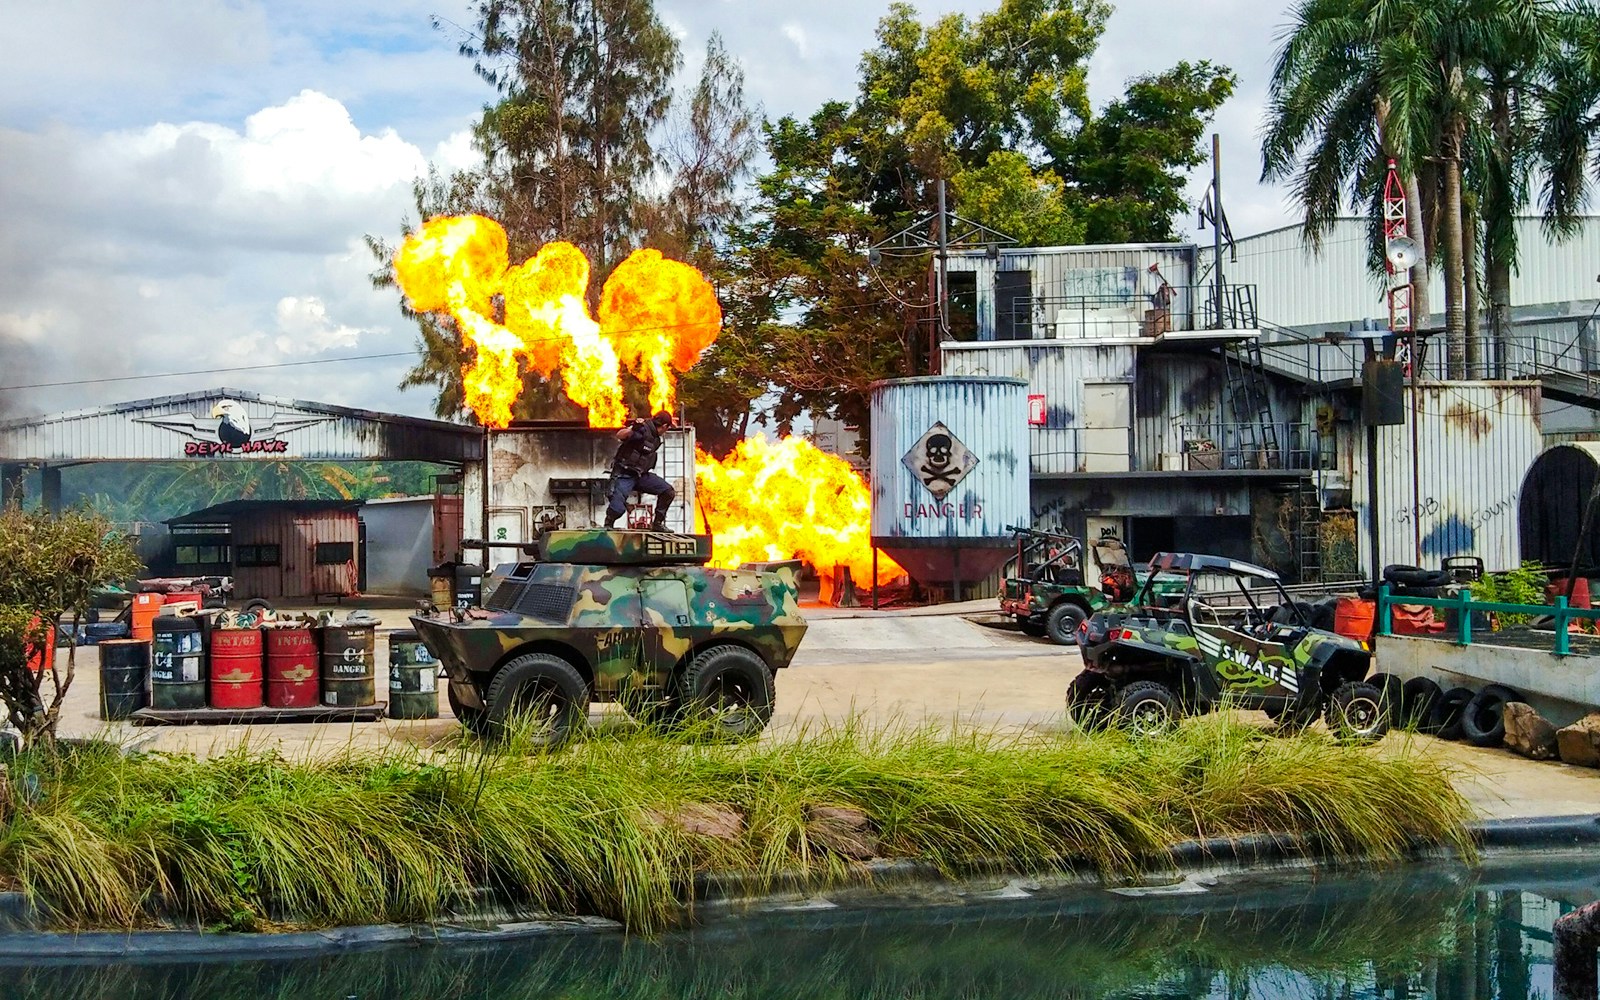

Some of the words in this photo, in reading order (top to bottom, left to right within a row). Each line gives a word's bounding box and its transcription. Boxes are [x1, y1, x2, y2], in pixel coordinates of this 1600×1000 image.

[185, 441, 234, 455] DEVIL
[241, 439, 288, 453] HAWK
[904, 502, 982, 519] DANGER
[1101, 525, 1118, 537] DON
[155, 652, 173, 668] C4
[343, 647, 365, 663] C4
[333, 665, 366, 673] DANGER
[1222, 645, 1280, 682] S.W.A.T.
